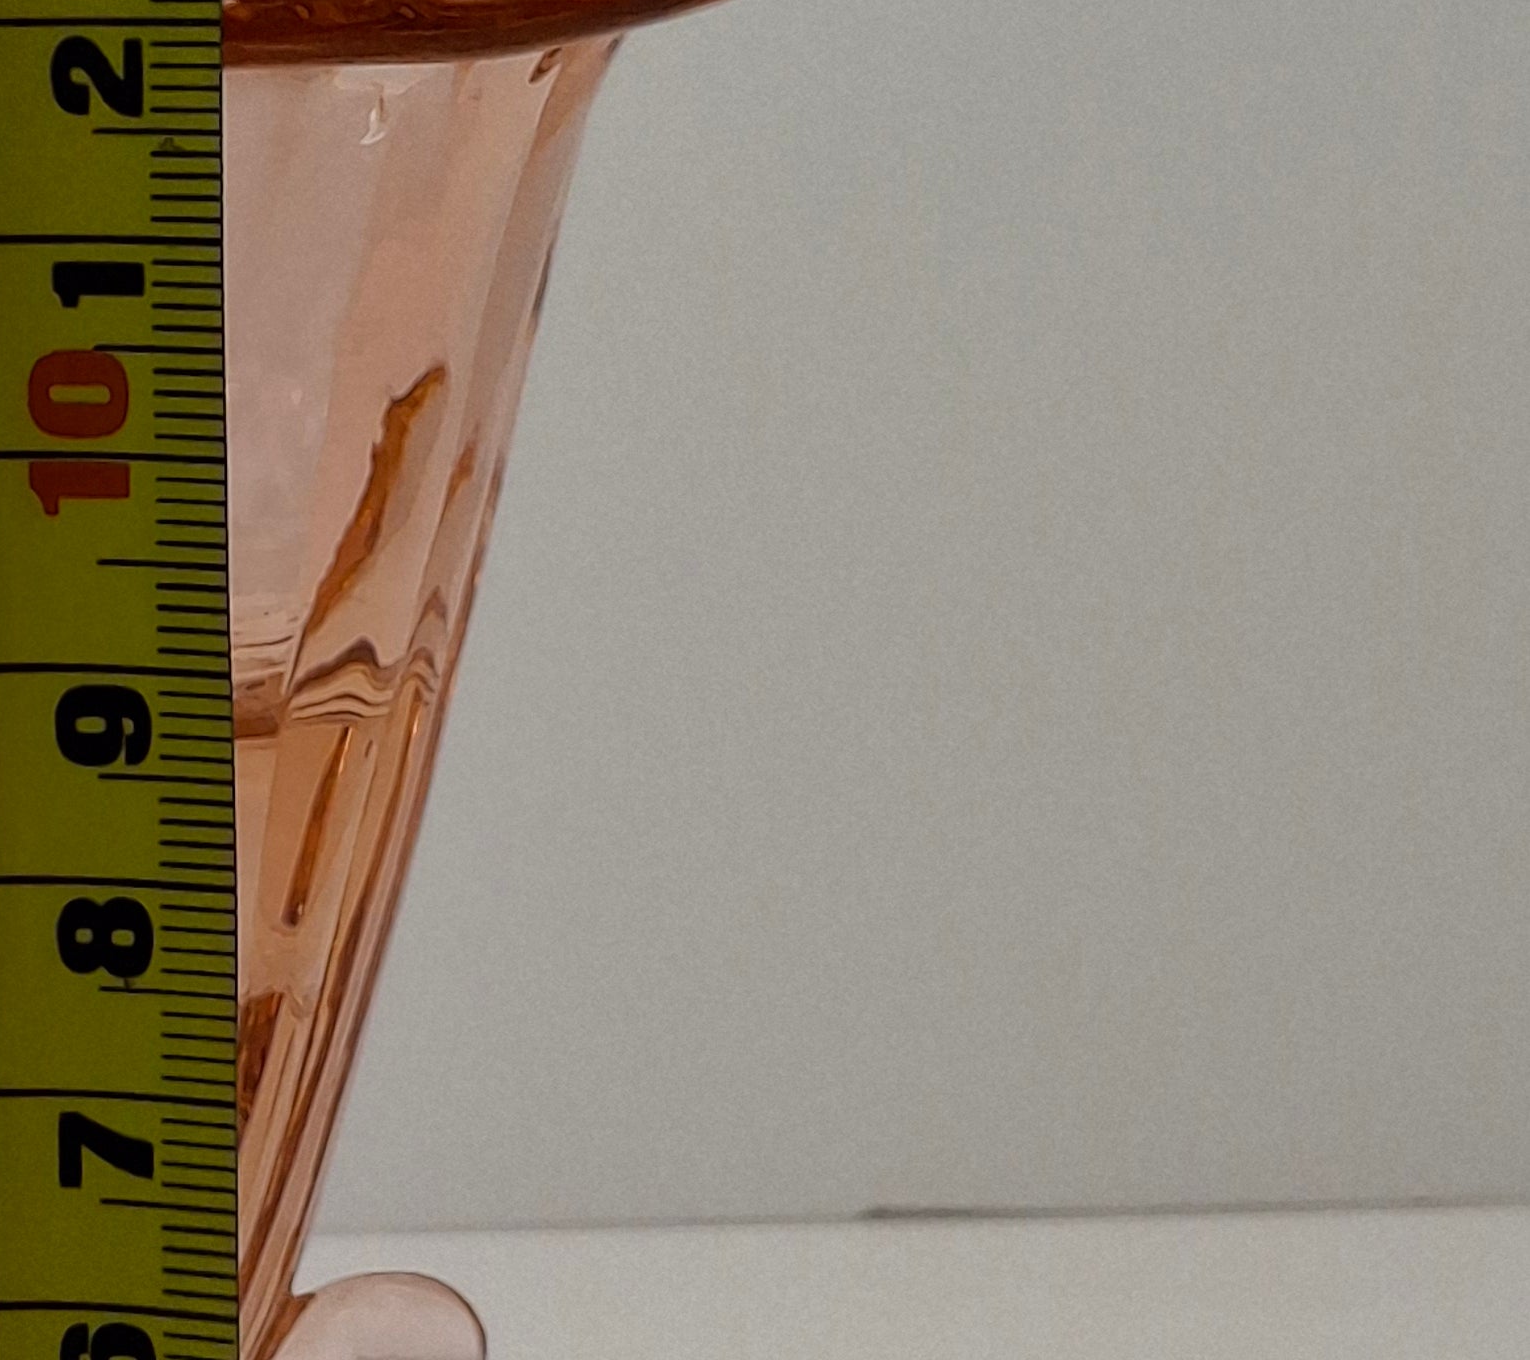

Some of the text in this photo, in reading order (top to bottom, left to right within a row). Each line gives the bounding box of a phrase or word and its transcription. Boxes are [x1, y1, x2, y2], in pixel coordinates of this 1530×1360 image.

[49, 35, 144, 118] 2
[51, 260, 146, 309] 1
[27, 348, 131, 518] 10
[54, 683, 152, 768] 9
[56, 896, 154, 980] 8
[57, 1110, 155, 1190] 7
